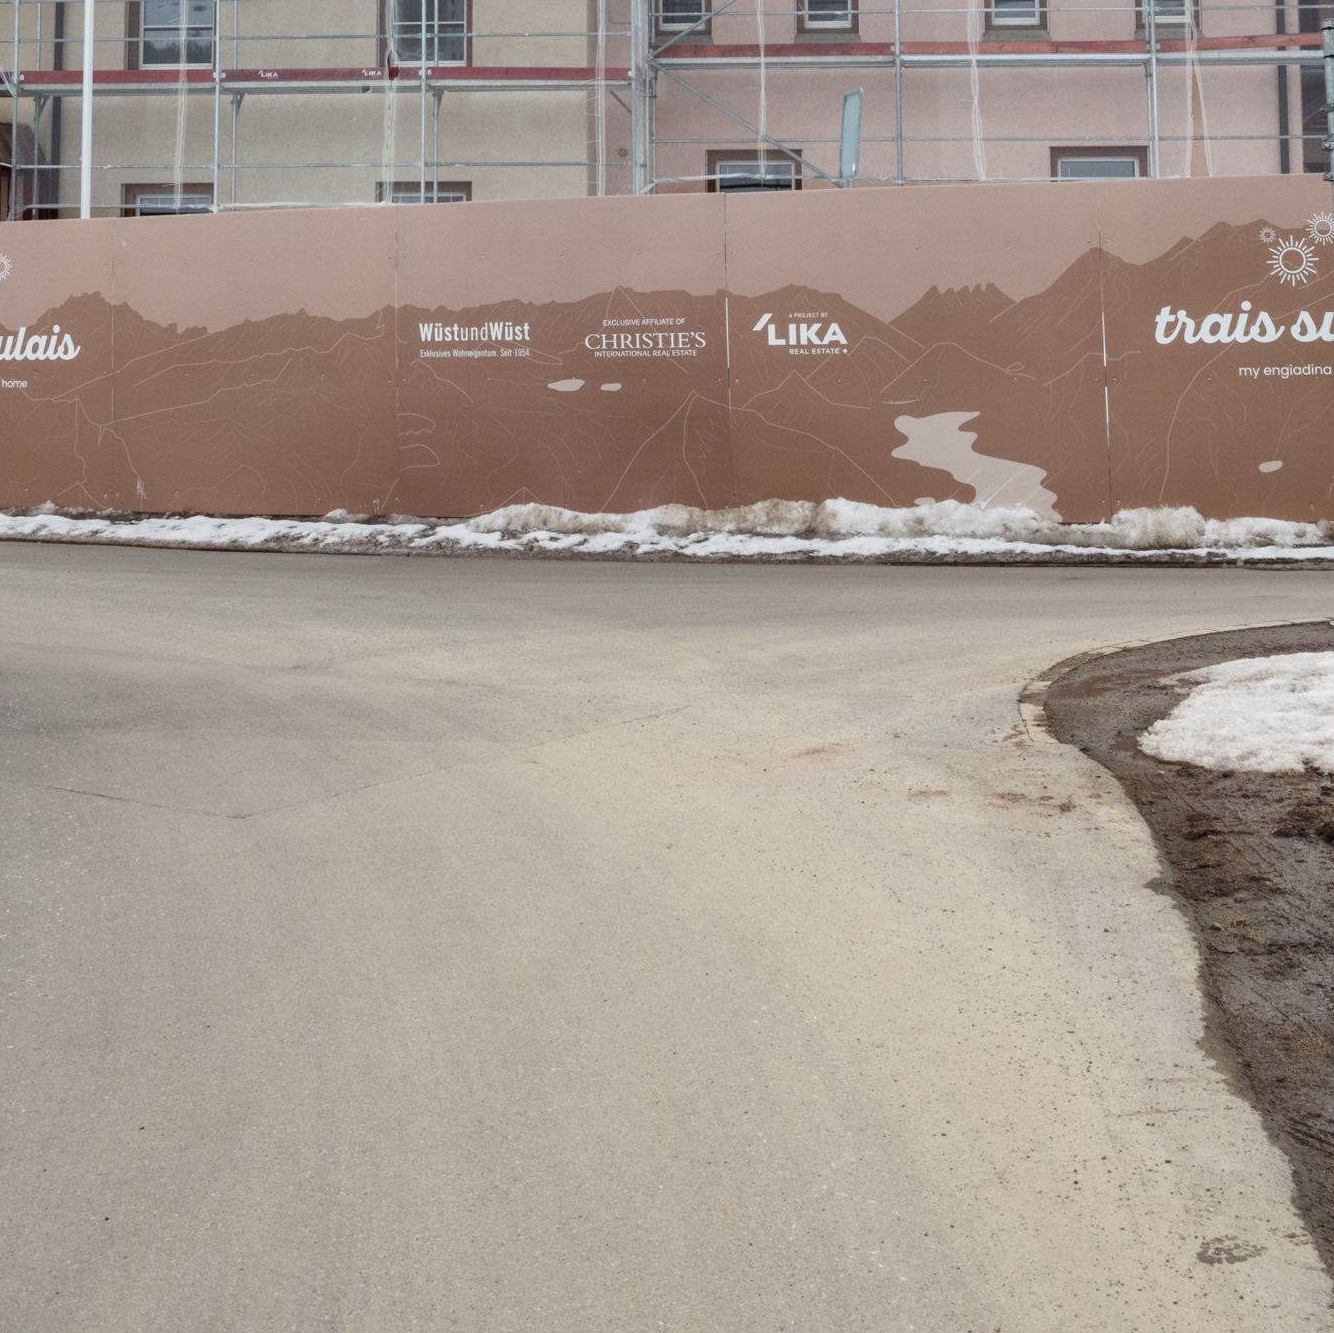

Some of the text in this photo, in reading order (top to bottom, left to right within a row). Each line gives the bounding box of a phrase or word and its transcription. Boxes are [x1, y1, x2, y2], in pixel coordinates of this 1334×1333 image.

[641, 318, 674, 326] AFFILIATE
[1154, 300, 1285, 344] trais
[419, 322, 530, 341] WüstundWüst
[767, 323, 848, 345] LIKA
[420, 349, 451, 357] Exklusives
[500, 348, 512, 357] Seit
[1239, 367, 1260, 379] my
[1263, 364, 1332, 379] engiadina
[2, 379, 28, 388] home
